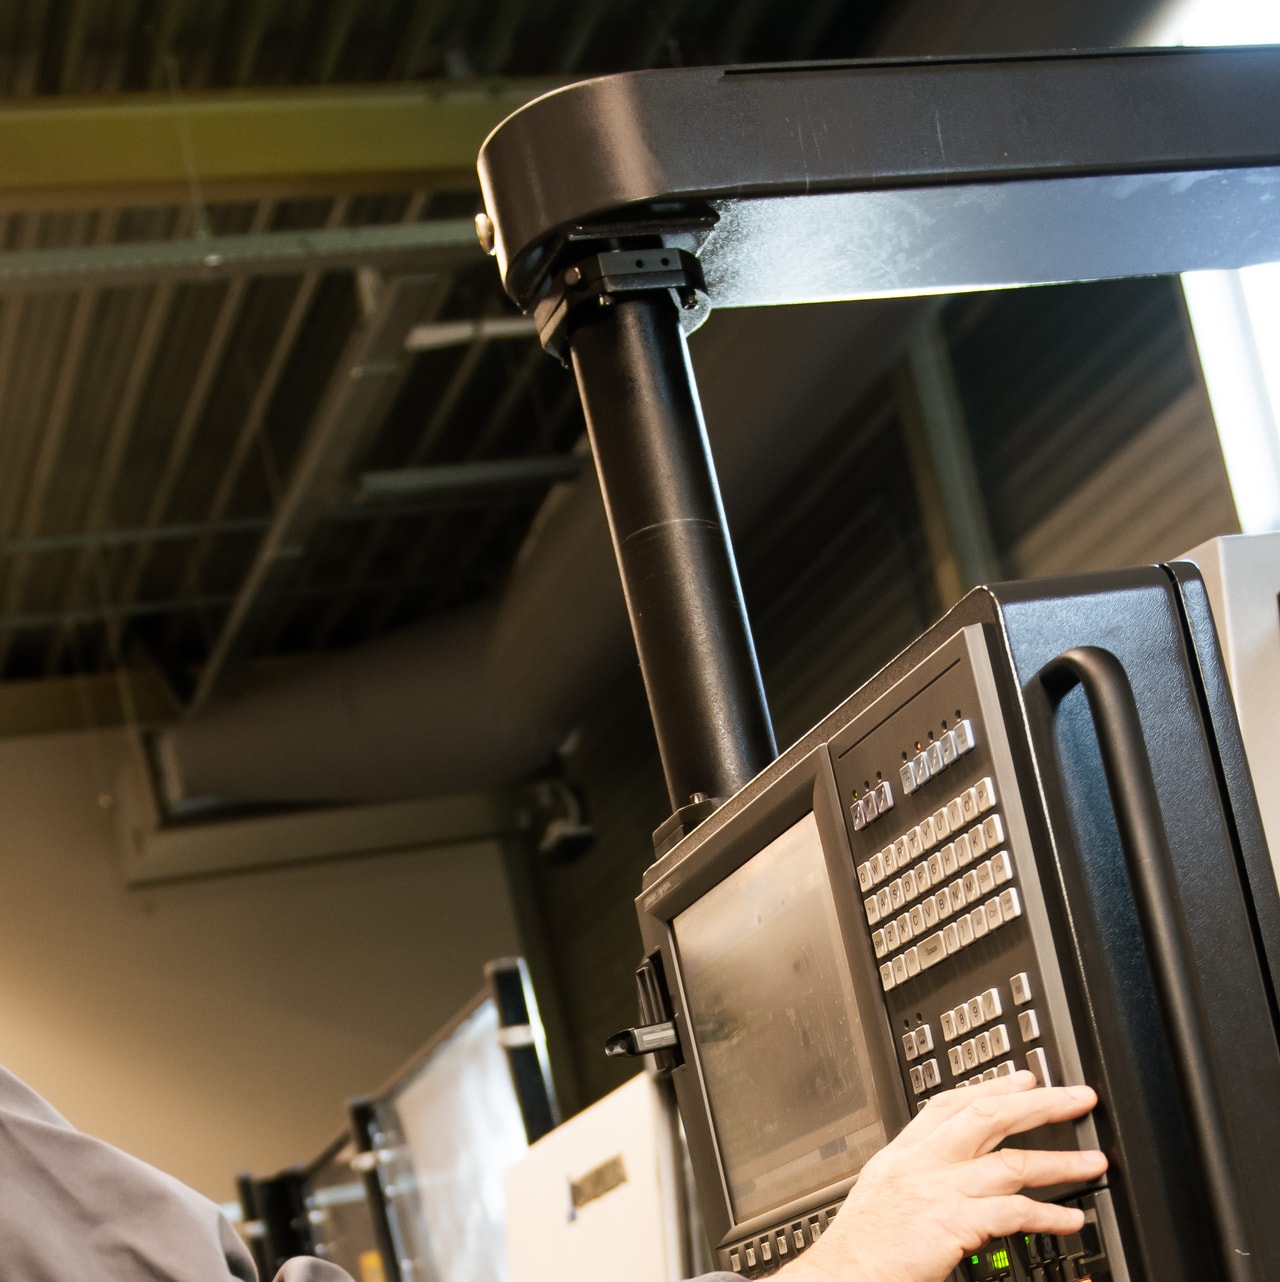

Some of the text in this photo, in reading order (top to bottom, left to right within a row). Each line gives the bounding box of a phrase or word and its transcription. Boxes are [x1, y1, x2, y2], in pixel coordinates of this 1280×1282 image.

[979, 790, 984, 801] P
[905, 880, 911, 893] D
[931, 863, 937, 875] G
[944, 853, 951, 865] H
[972, 835, 978, 846] K
[888, 930, 894, 942] Z
[912, 914, 919, 926] C
[925, 907, 931, 918] V
[939, 898, 945, 910] B
[959, 1013, 965, 1024] 8
[972, 1006, 978, 1017] 9
[981, 1042, 987, 1052] 6
